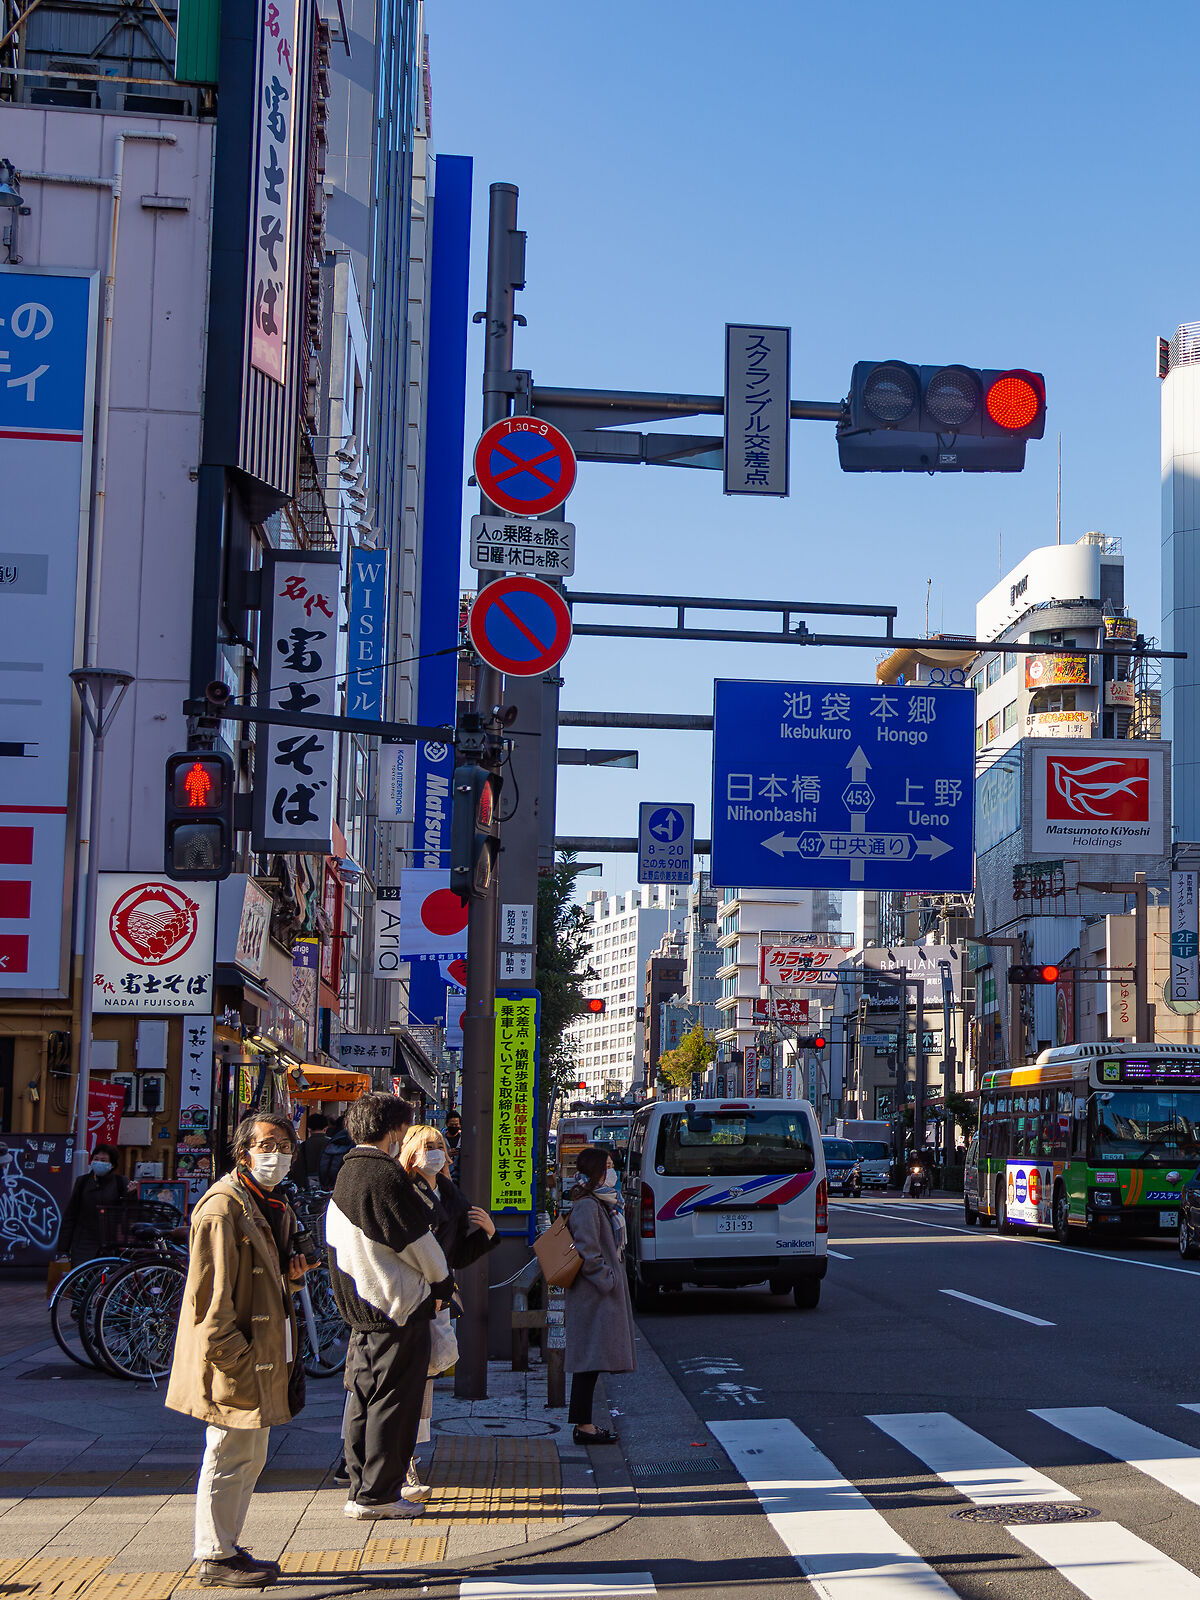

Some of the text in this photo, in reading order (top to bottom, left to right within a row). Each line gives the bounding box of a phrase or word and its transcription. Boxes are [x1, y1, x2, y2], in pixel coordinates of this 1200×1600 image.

[255, 75, 290, 337] 富士そば
[0, 302, 54, 341] の
[744, 334, 771, 486] スクランブル交差点
[476, 522, 570, 547] 人の乗降を除く
[476, 546, 569, 569] 日曜・休日を除く
[279, 575, 334, 618] 名代
[354, 561, 382, 712] WISEビル
[782, 691, 937, 725] 池袋 本郷
[1026, 717, 1036, 726] 8F
[780, 723, 928, 745] Ikebukuro Hongo
[727, 773, 822, 804] 日本橋
[896, 778, 963, 808] 上野
[845, 791, 871, 806] 453
[727, 805, 950, 826] Nihonbashi Ueno
[1046, 825, 1151, 838] Matsumoto KiYoshi
[800, 838, 823, 853] 437
[829, 836, 905, 856] 中央通り
[1072, 837, 1123, 849] Holdings
[642, 858, 690, 869] この先90m
[506, 909, 516, 975] 防犯カメ作動中
[1177, 933, 1193, 943] 2F
[1177, 947, 1193, 957] 1F
[120, 972, 212, 995] 富士そば
[1175, 963, 1190, 998] Aria
[104, 998, 195, 1008] NADAI FUJISOBA
[341, 1045, 392, 1057] 回転寿司
[497, 1005, 514, 1187] 乗車していても取締りを行います。
[513, 1005, 530, 1186] 交差点・横断歩道は駐停車禁止です。
[725, 1221, 753, 1231] 31-93
